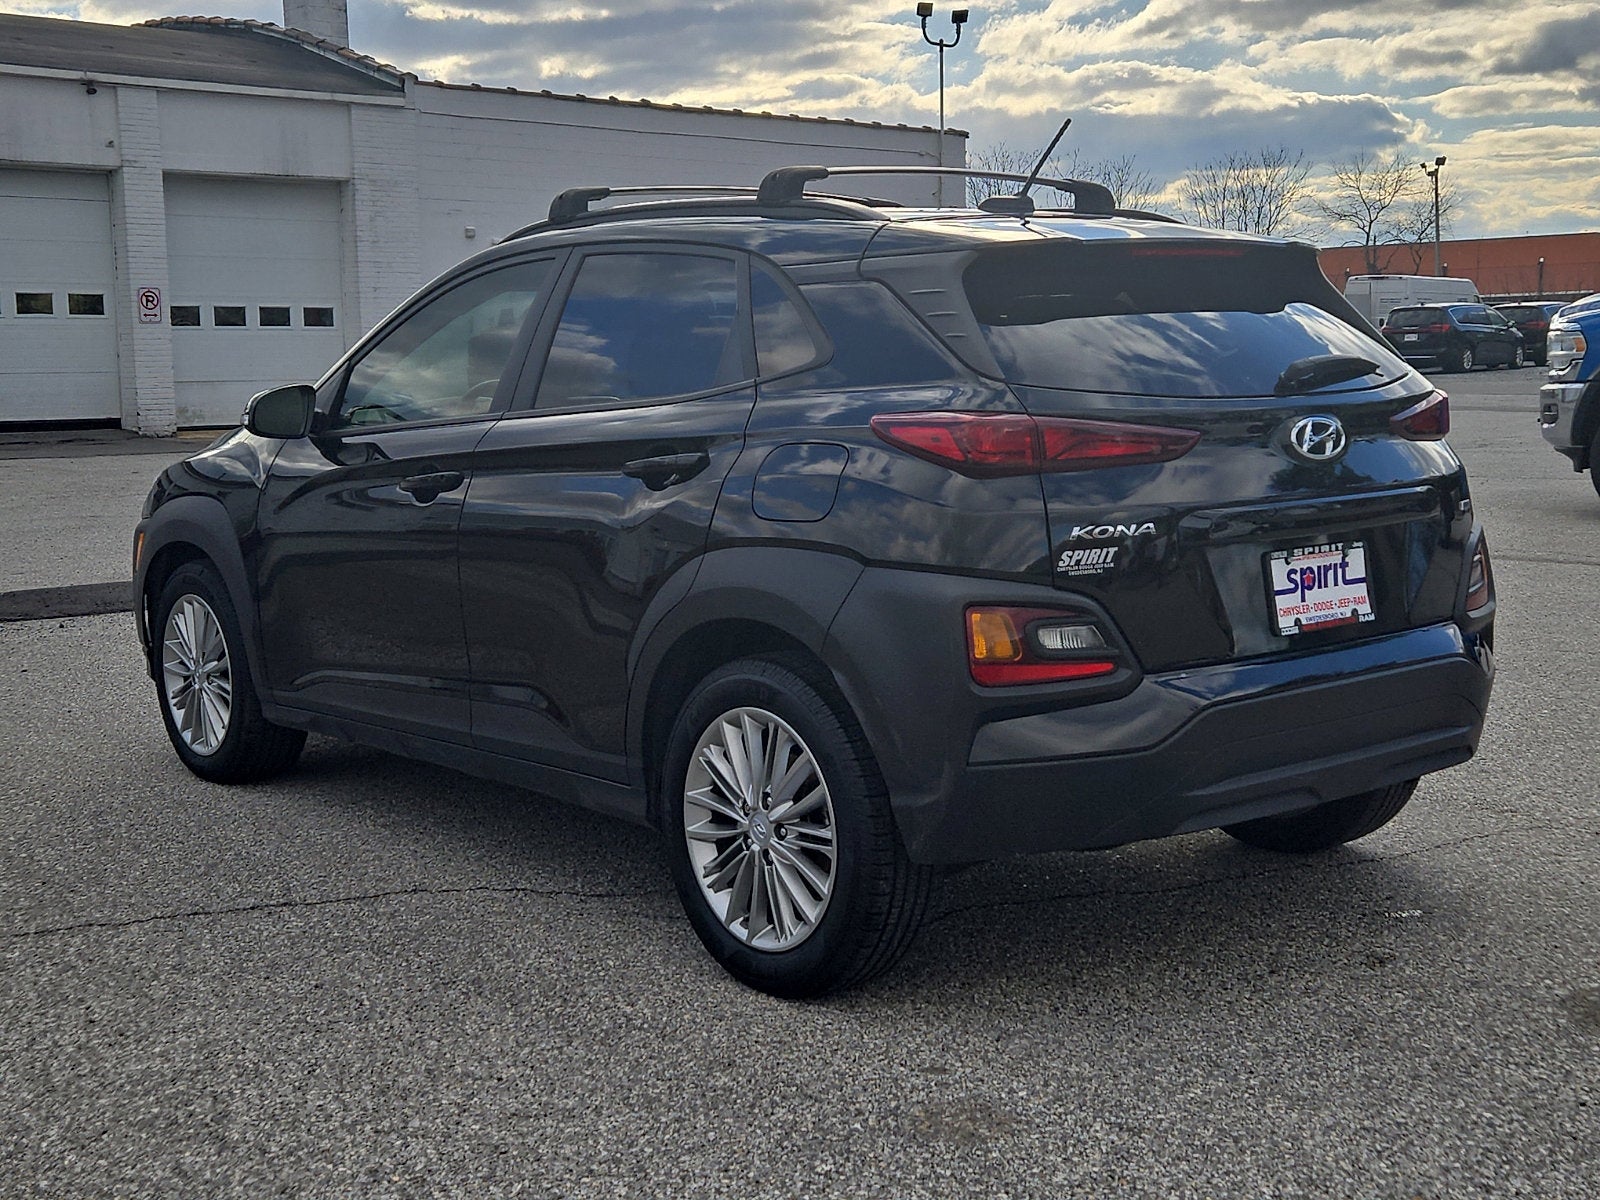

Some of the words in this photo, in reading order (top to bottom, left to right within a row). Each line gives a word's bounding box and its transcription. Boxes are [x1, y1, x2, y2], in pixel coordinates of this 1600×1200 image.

[1070, 522, 1157, 540] KONA
[1058, 547, 1119, 567] SPIRIT
[1293, 542, 1344, 556] SPIRIT
[1275, 556, 1366, 603] spirit
[1279, 604, 1311, 617] CHRYSLER
[1314, 600, 1334, 612] DODGE
[1337, 598, 1351, 608] JEEP
[1354, 595, 1367, 606] RAM
[1359, 613, 1376, 622] RAM
